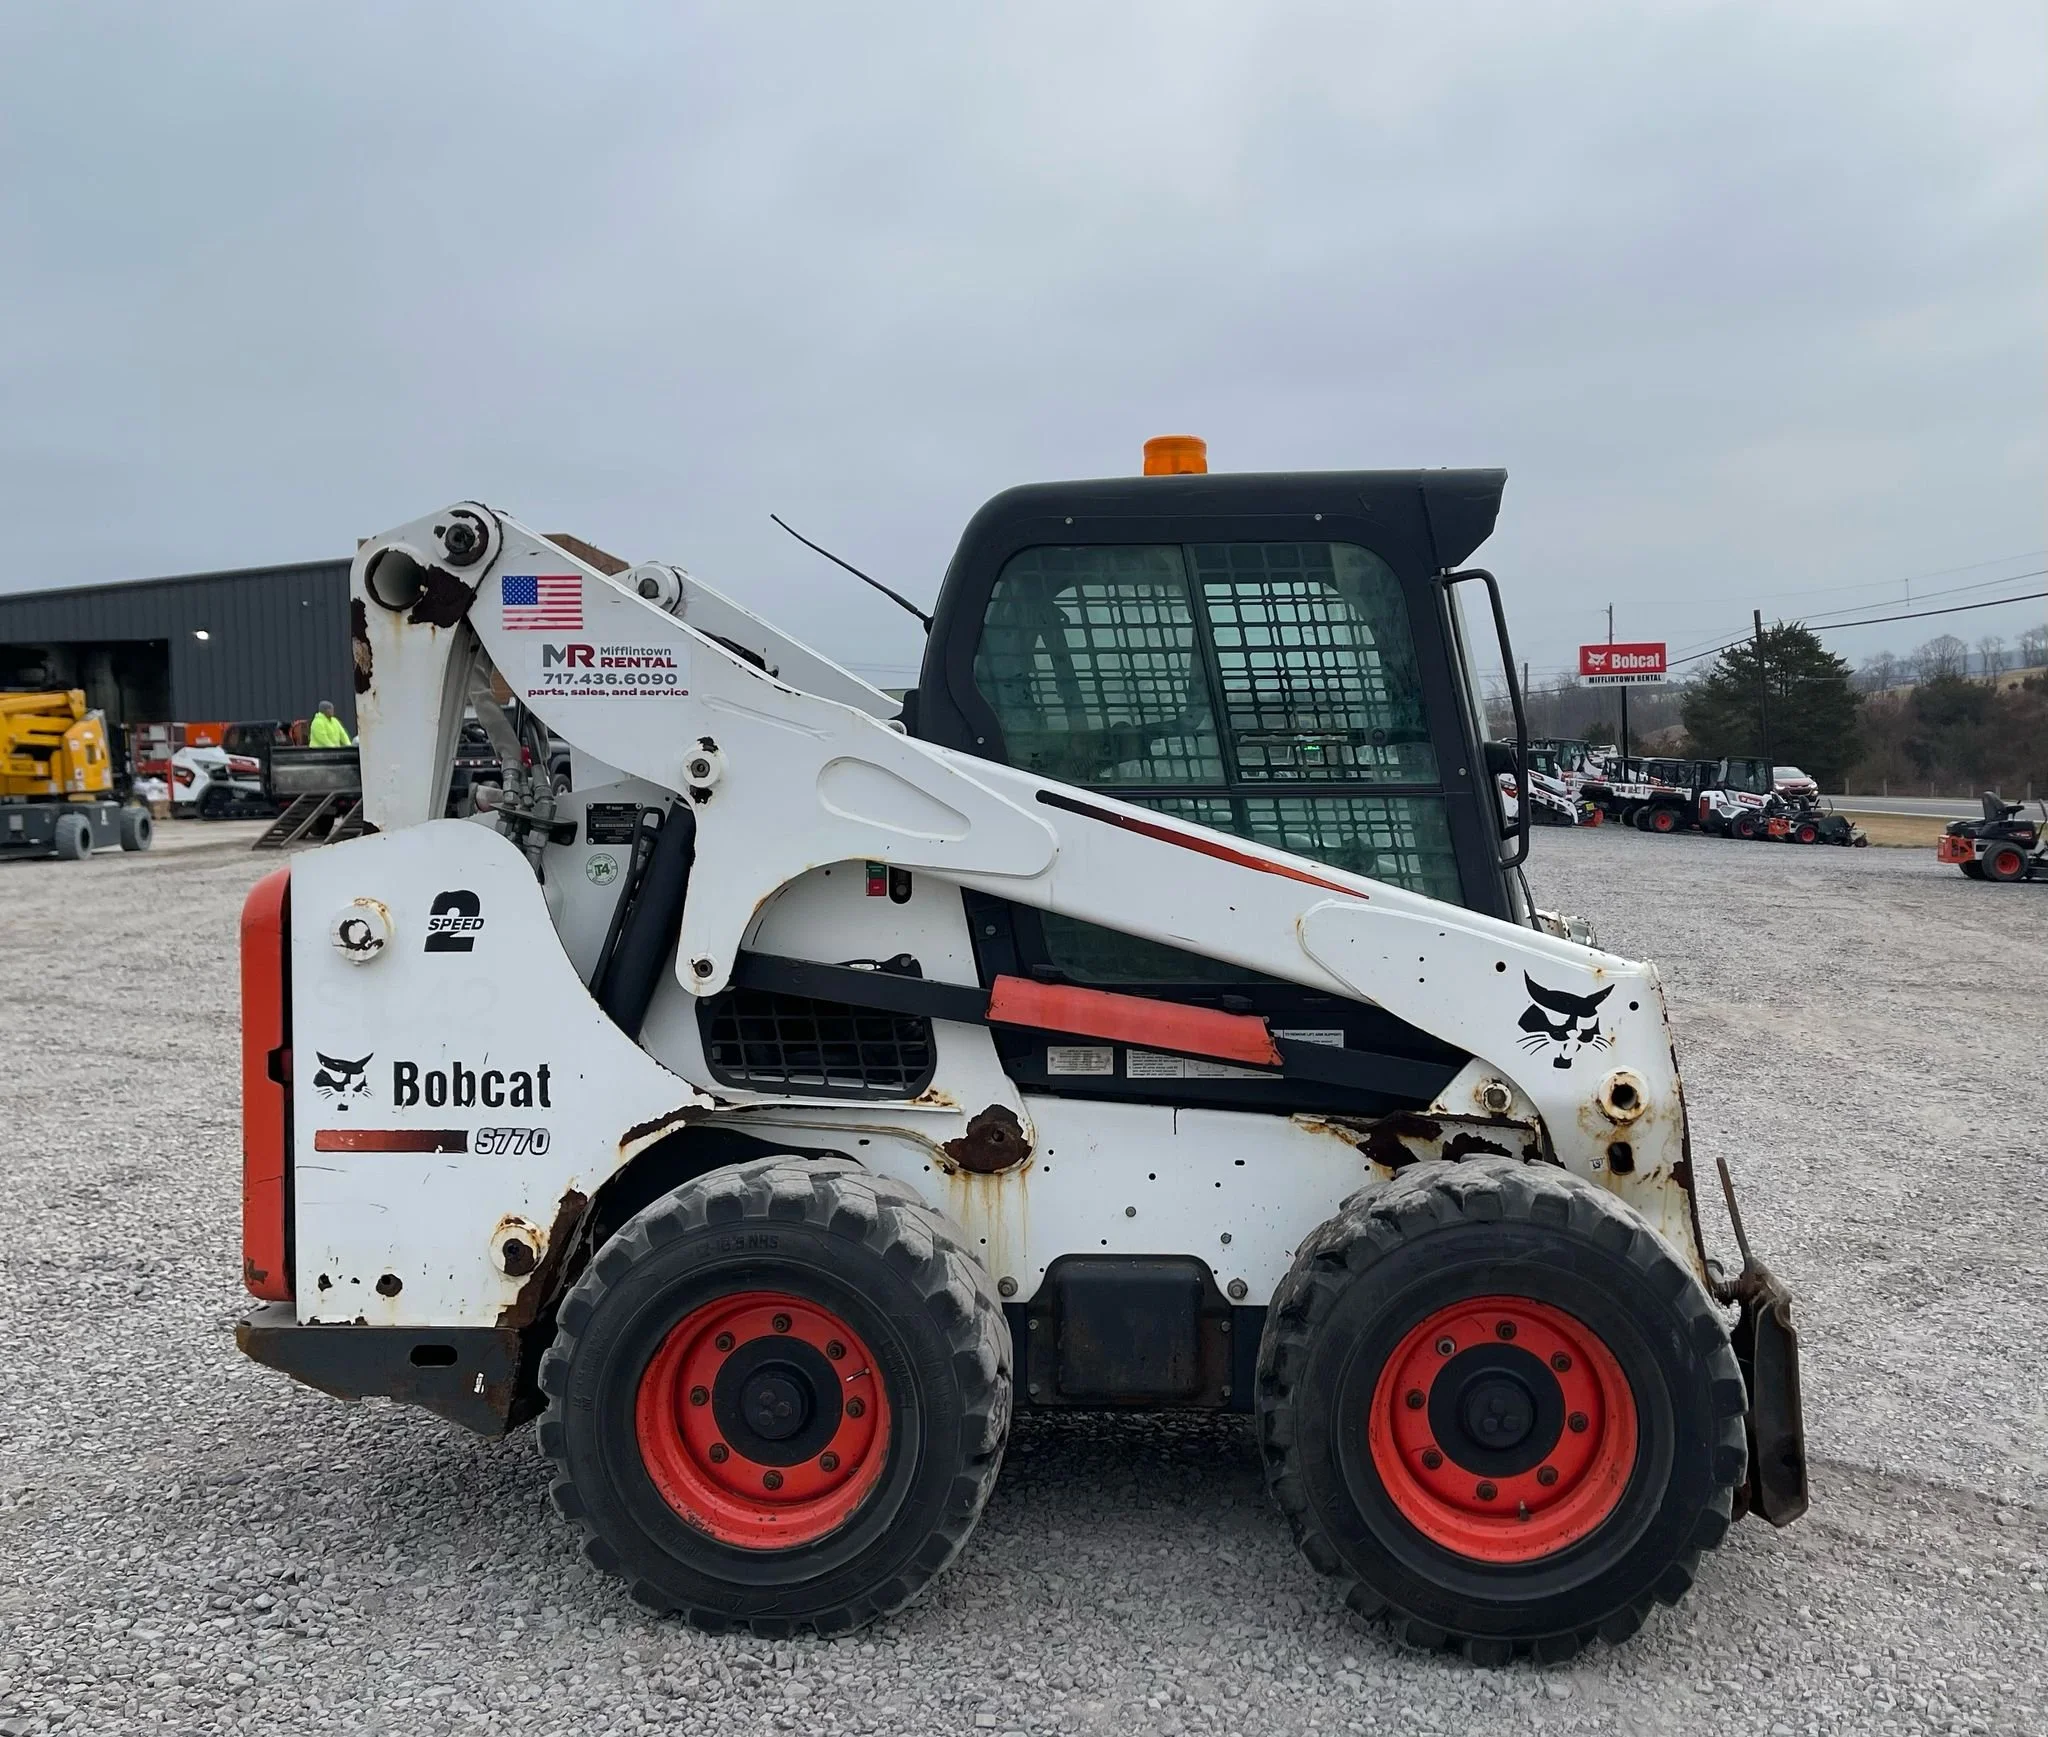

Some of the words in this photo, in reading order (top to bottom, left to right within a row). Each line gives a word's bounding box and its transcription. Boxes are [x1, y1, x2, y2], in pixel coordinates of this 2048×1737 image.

[542, 643, 596, 668] MR
[600, 646, 672, 656] Mifflintown
[600, 657, 678, 668] RENTAL
[1611, 652, 1660, 669] Bobcat
[543, 673, 678, 685] 717.436.6090
[1588, 674, 1635, 684] MIFFLINTOWN
[1637, 674, 1662, 682] RENTAL
[527, 687, 569, 697] parts,
[570, 687, 610, 697] sales,
[612, 687, 638, 696] and
[639, 687, 689, 696] service
[423, 889, 482, 953] 2
[427, 918, 485, 931] SPEED
[392, 1060, 552, 1108] Bobcat
[474, 1127, 551, 1156] S770
